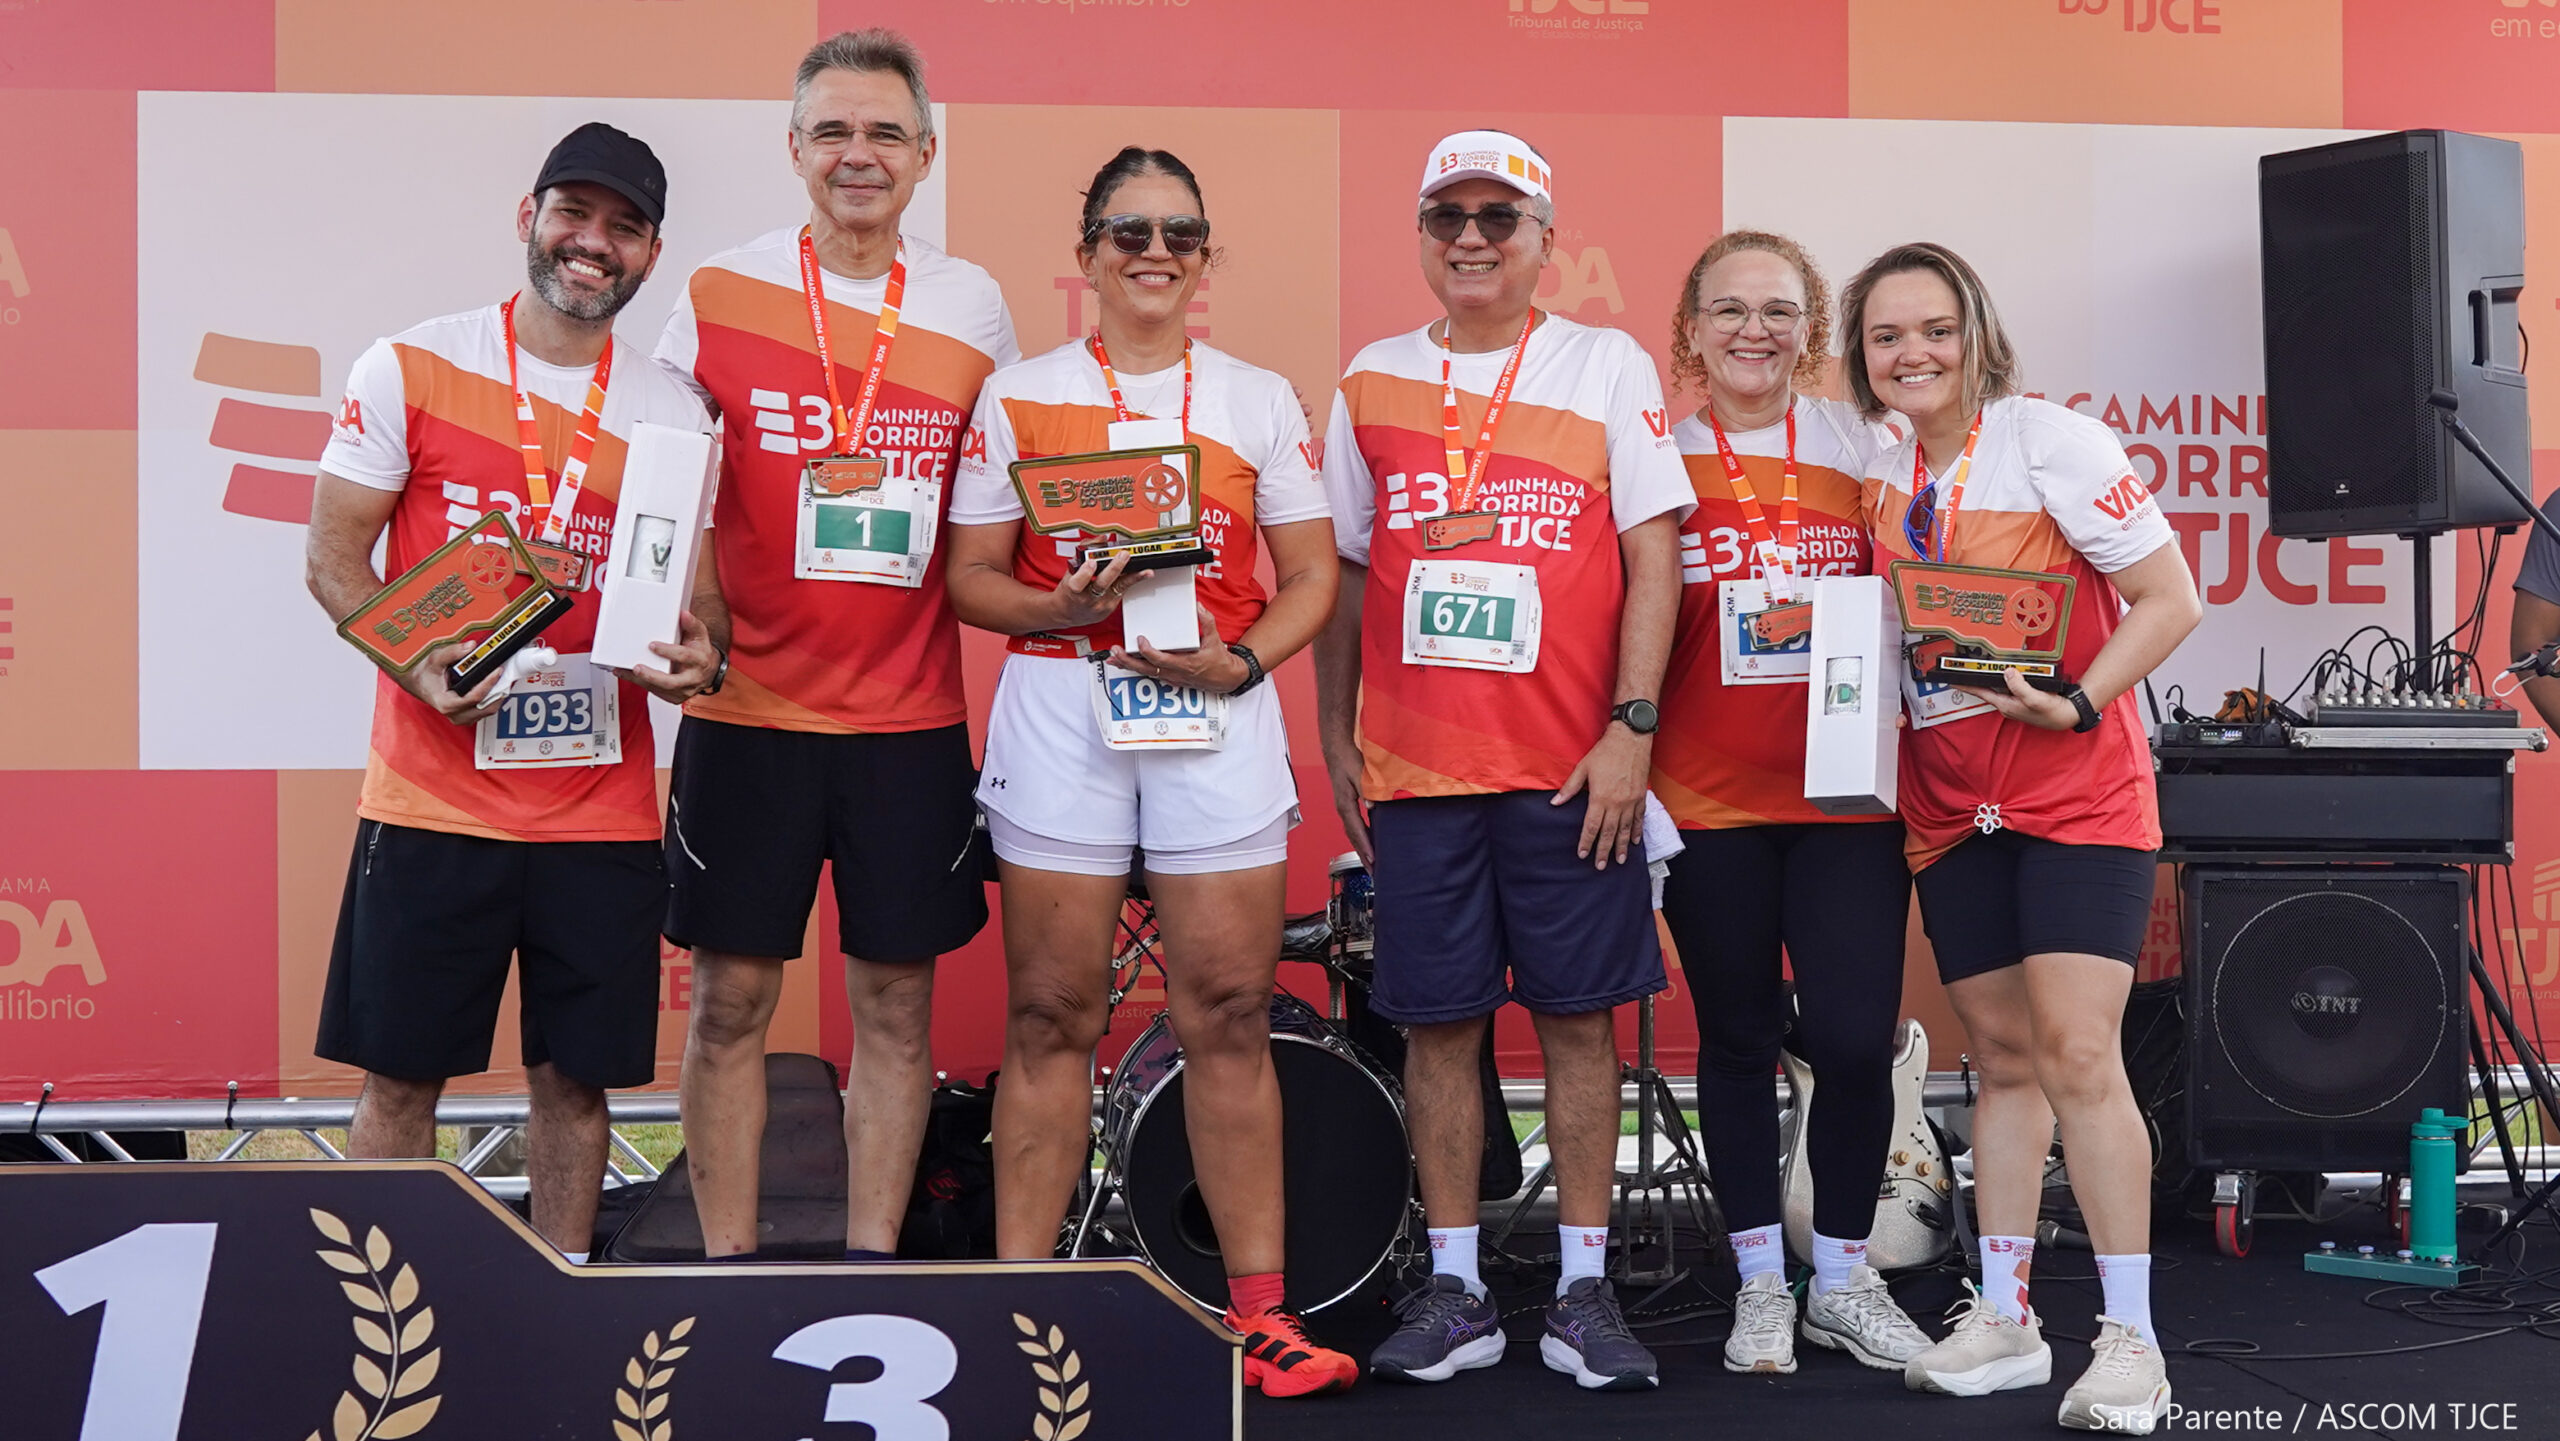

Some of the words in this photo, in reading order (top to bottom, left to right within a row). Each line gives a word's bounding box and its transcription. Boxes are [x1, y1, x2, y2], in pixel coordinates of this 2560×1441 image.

[1507, 15, 1568, 30] Tribunal
[1571, 16, 1590, 30] de
[1594, 17, 1645, 33] Justiça
[2490, 18, 2531, 38] em
[847, 398, 871, 456] ADA/CORRIDA
[864, 385, 875, 397] DO
[875, 344, 887, 363] 2026
[847, 407, 960, 428] MINHADA
[865, 425, 953, 448] ORRIDA
[880, 450, 949, 484] TJCE
[1477, 477, 1585, 499] AMINHADA
[1079, 496, 1098, 508] DO
[1100, 492, 1135, 511] TJCE
[855, 510, 871, 548] 1
[1497, 515, 1572, 551] TJCE
[1133, 544, 1163, 555] LUGAR
[1709, 526, 1750, 574] 3ª
[1411, 575, 1422, 595] 3KM
[420, 610, 439, 629] DO
[436, 586, 476, 619] TJCE
[1433, 595, 1497, 636] 671
[1727, 597, 1736, 617] 5KM
[1950, 606, 1968, 618] DO
[1969, 607, 2004, 625] TJCE
[494, 619, 521, 643] LUGAR
[1113, 678, 1204, 717] 1930
[501, 691, 591, 735] 1933
[34, 1221, 218, 1441] 1
